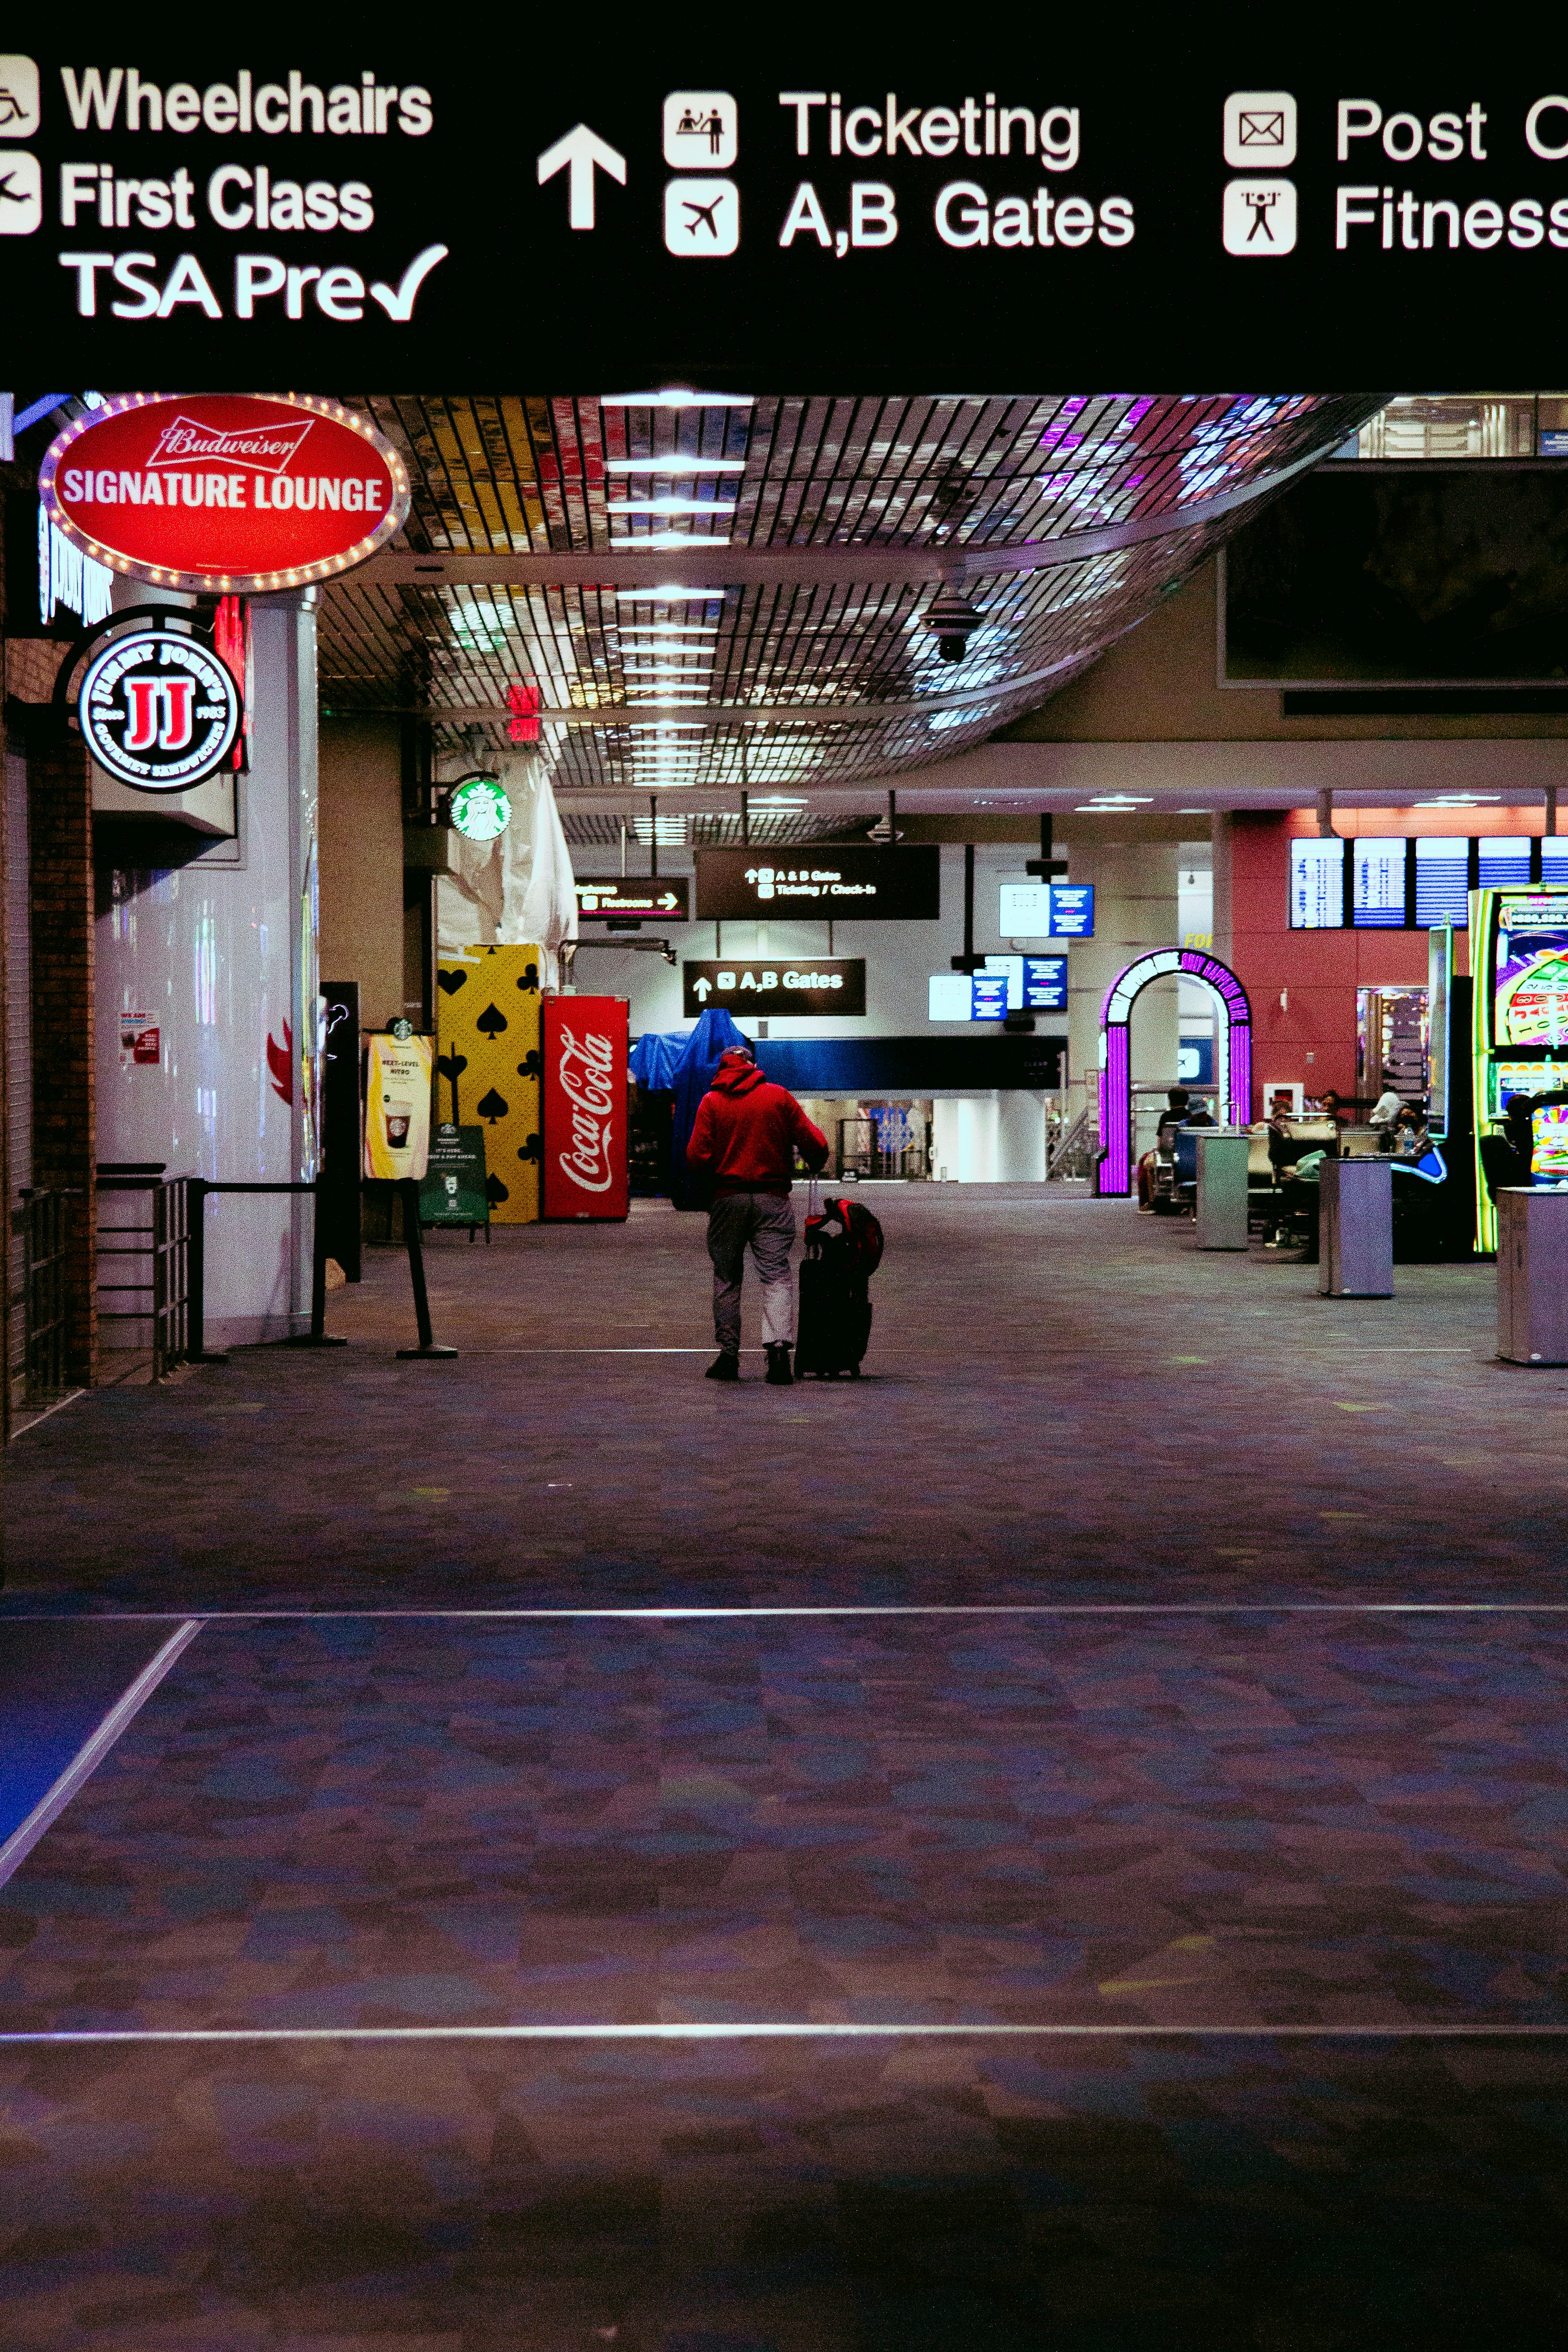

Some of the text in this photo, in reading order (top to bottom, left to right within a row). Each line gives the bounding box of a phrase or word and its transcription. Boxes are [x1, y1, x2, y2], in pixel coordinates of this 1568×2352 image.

[60, 67, 434, 135] Wheelchairs
[779, 92, 1080, 172] Ticketing
[1337, 99, 1488, 161] Post
[60, 163, 375, 231] First Class
[779, 181, 1136, 258] A,B Gates
[1336, 186, 1568, 249] Fitness
[58, 252, 223, 319] TSA
[161, 428, 298, 455] Budweiser
[62, 468, 383, 512] SIGNATURE LOUNGE
[91, 643, 227, 705] JIMMY JOHN'S
[123, 675, 196, 751] JJ
[602, 897, 653, 908] Restrooms
[775, 870, 786, 881] A
[799, 870, 810, 882] B
[811, 870, 842, 882] Gates
[775, 884, 820, 897] Ticketing
[739, 970, 843, 992] A,B Gates
[1202, 960, 1242, 999] HAPPENS
[1227, 996, 1248, 1023] HERE
